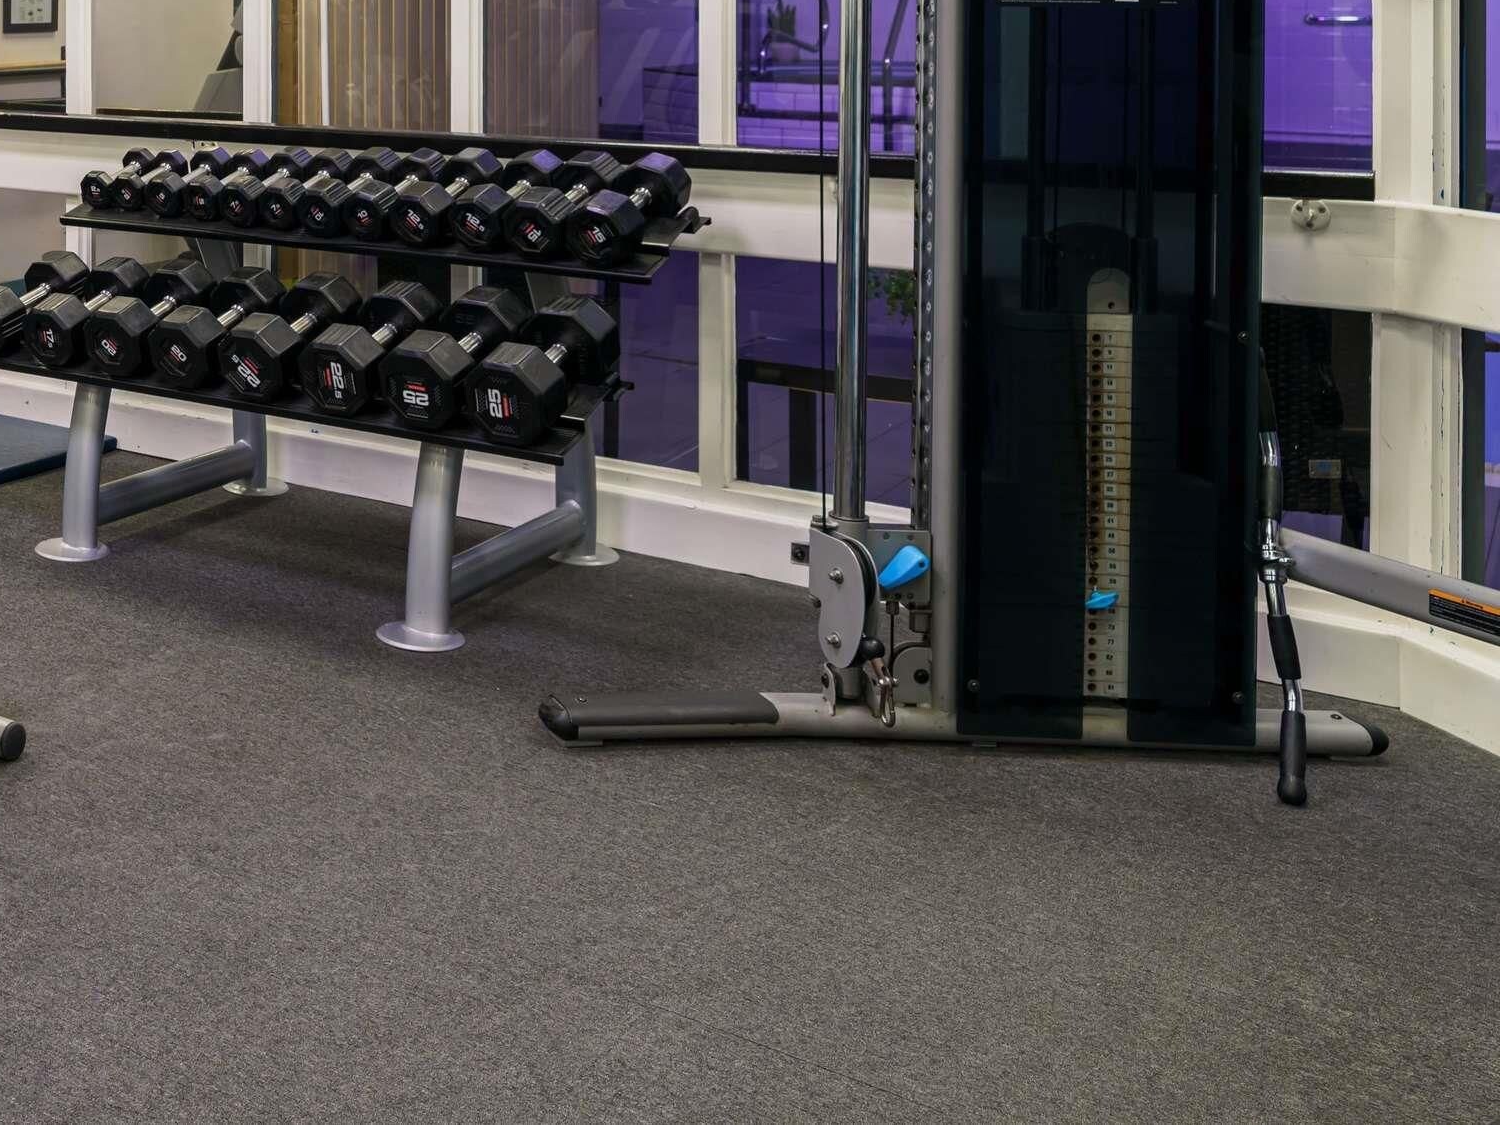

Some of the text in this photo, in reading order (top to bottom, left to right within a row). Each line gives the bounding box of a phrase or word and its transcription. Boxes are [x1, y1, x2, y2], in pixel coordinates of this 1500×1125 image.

[527, 228, 542, 243] 15
[593, 225, 606, 244] 15
[100, 338, 117, 357] 20
[170, 344, 187, 363] 20
[231, 353, 261, 389] 22.5
[329, 361, 343, 400] 22.5
[402, 389, 430, 407] 25
[487, 388, 503, 419] 25
